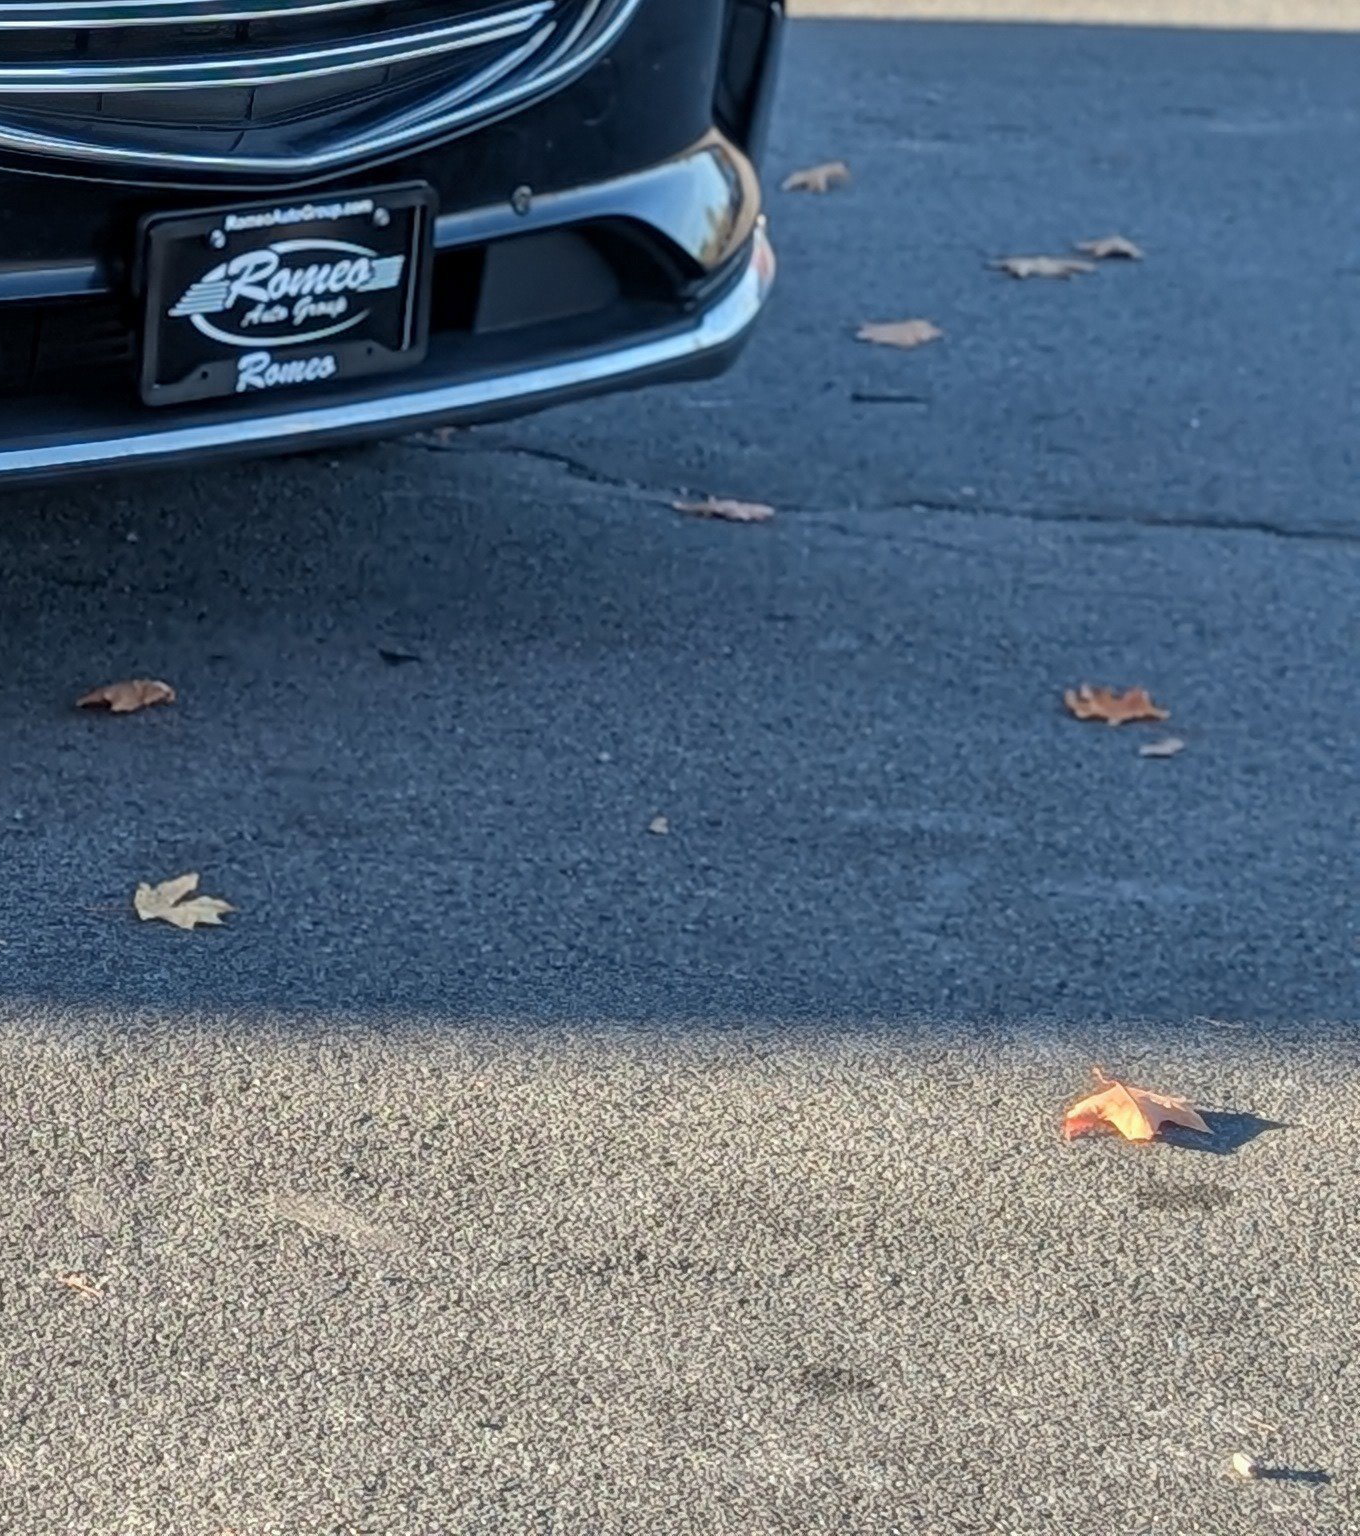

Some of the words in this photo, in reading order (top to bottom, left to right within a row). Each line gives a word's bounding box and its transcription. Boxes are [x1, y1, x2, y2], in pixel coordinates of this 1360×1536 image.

[224, 249, 374, 309] Romeo
[240, 302, 289, 329] Auto
[293, 296, 348, 327] Group
[236, 351, 337, 393] Romeo
